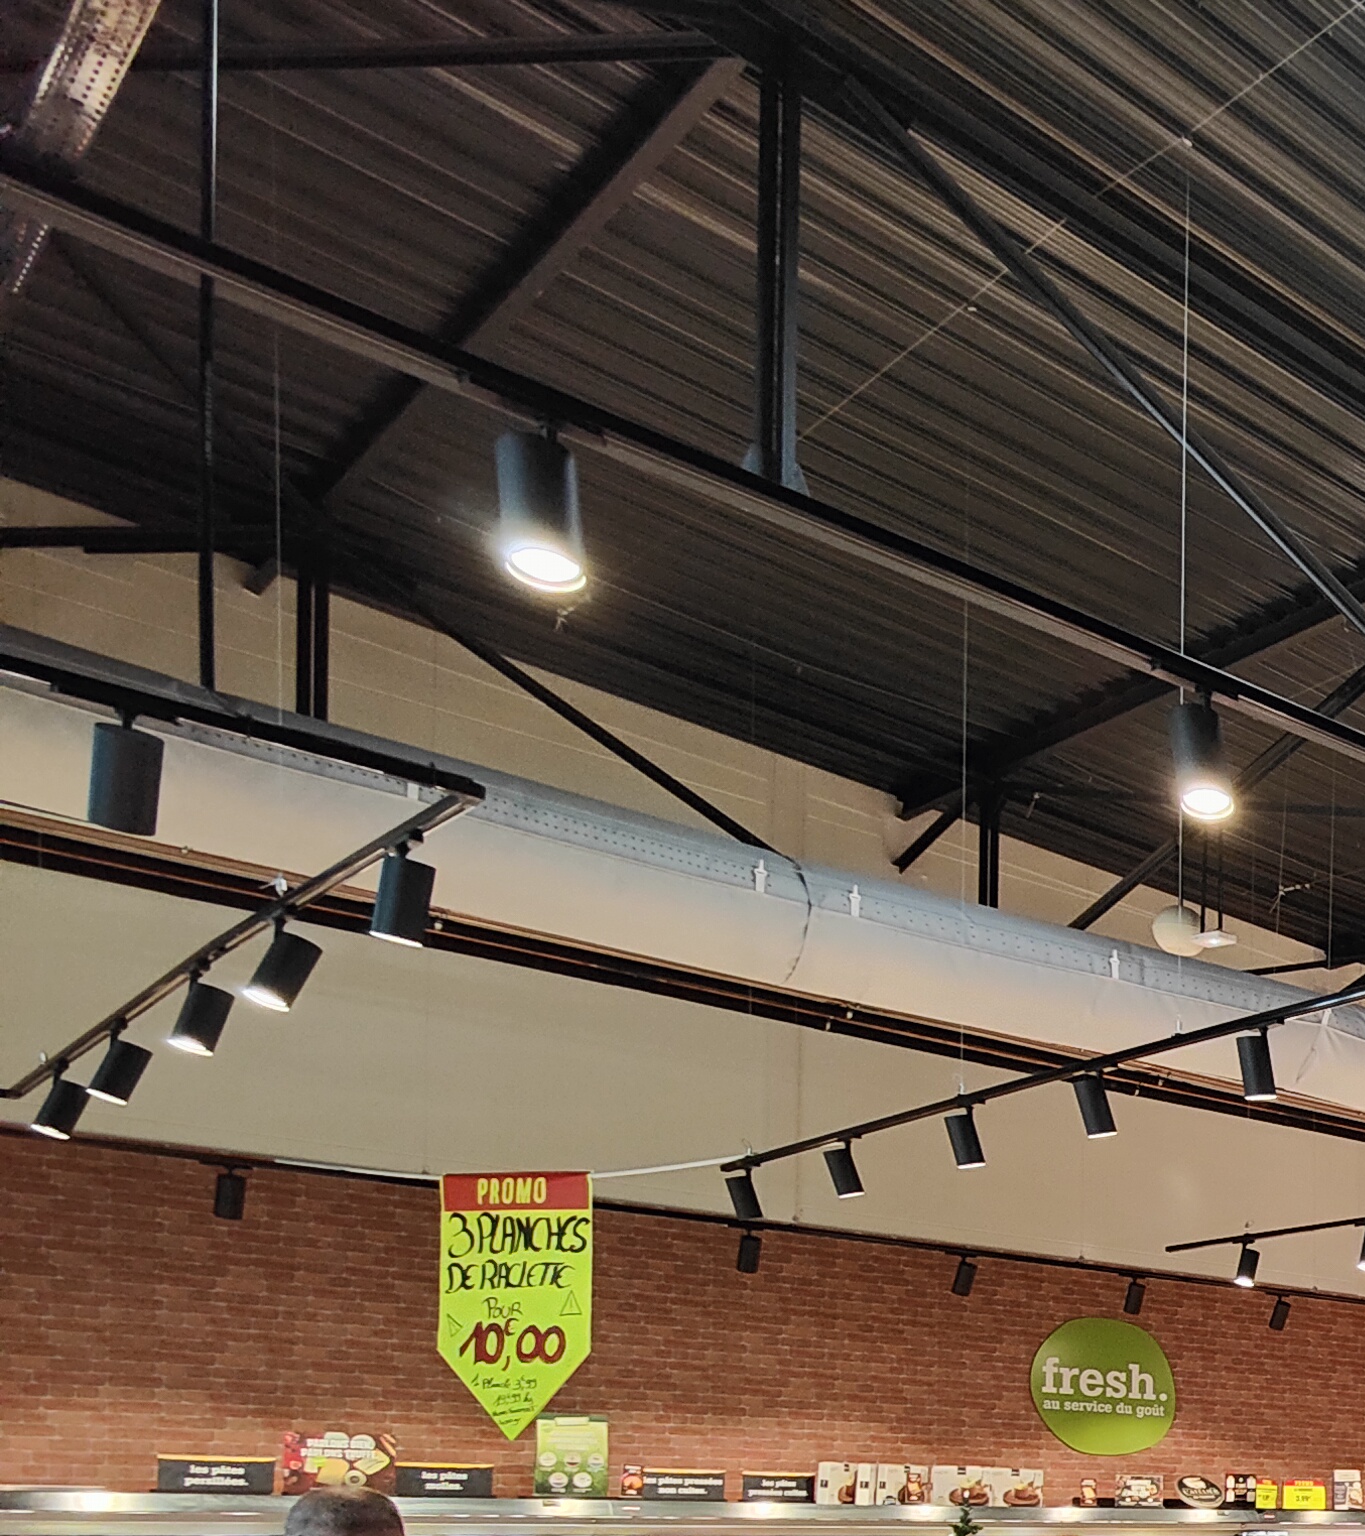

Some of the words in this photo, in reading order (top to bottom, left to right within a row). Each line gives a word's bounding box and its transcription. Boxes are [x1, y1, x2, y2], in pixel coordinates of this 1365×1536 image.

[477, 1177, 547, 1205] PROMO
[448, 1212, 474, 1258] 3
[477, 1212, 590, 1254] PLANCHES
[445, 1262, 479, 1294] DE
[480, 1259, 575, 1290] RACLETTE
[1042, 1357, 1168, 1402] fresh.
[1043, 1399, 1060, 1410] au
[1064, 1400, 1113, 1413] service
[1116, 1402, 1133, 1415] du
[1136, 1404, 1165, 1418] goût
